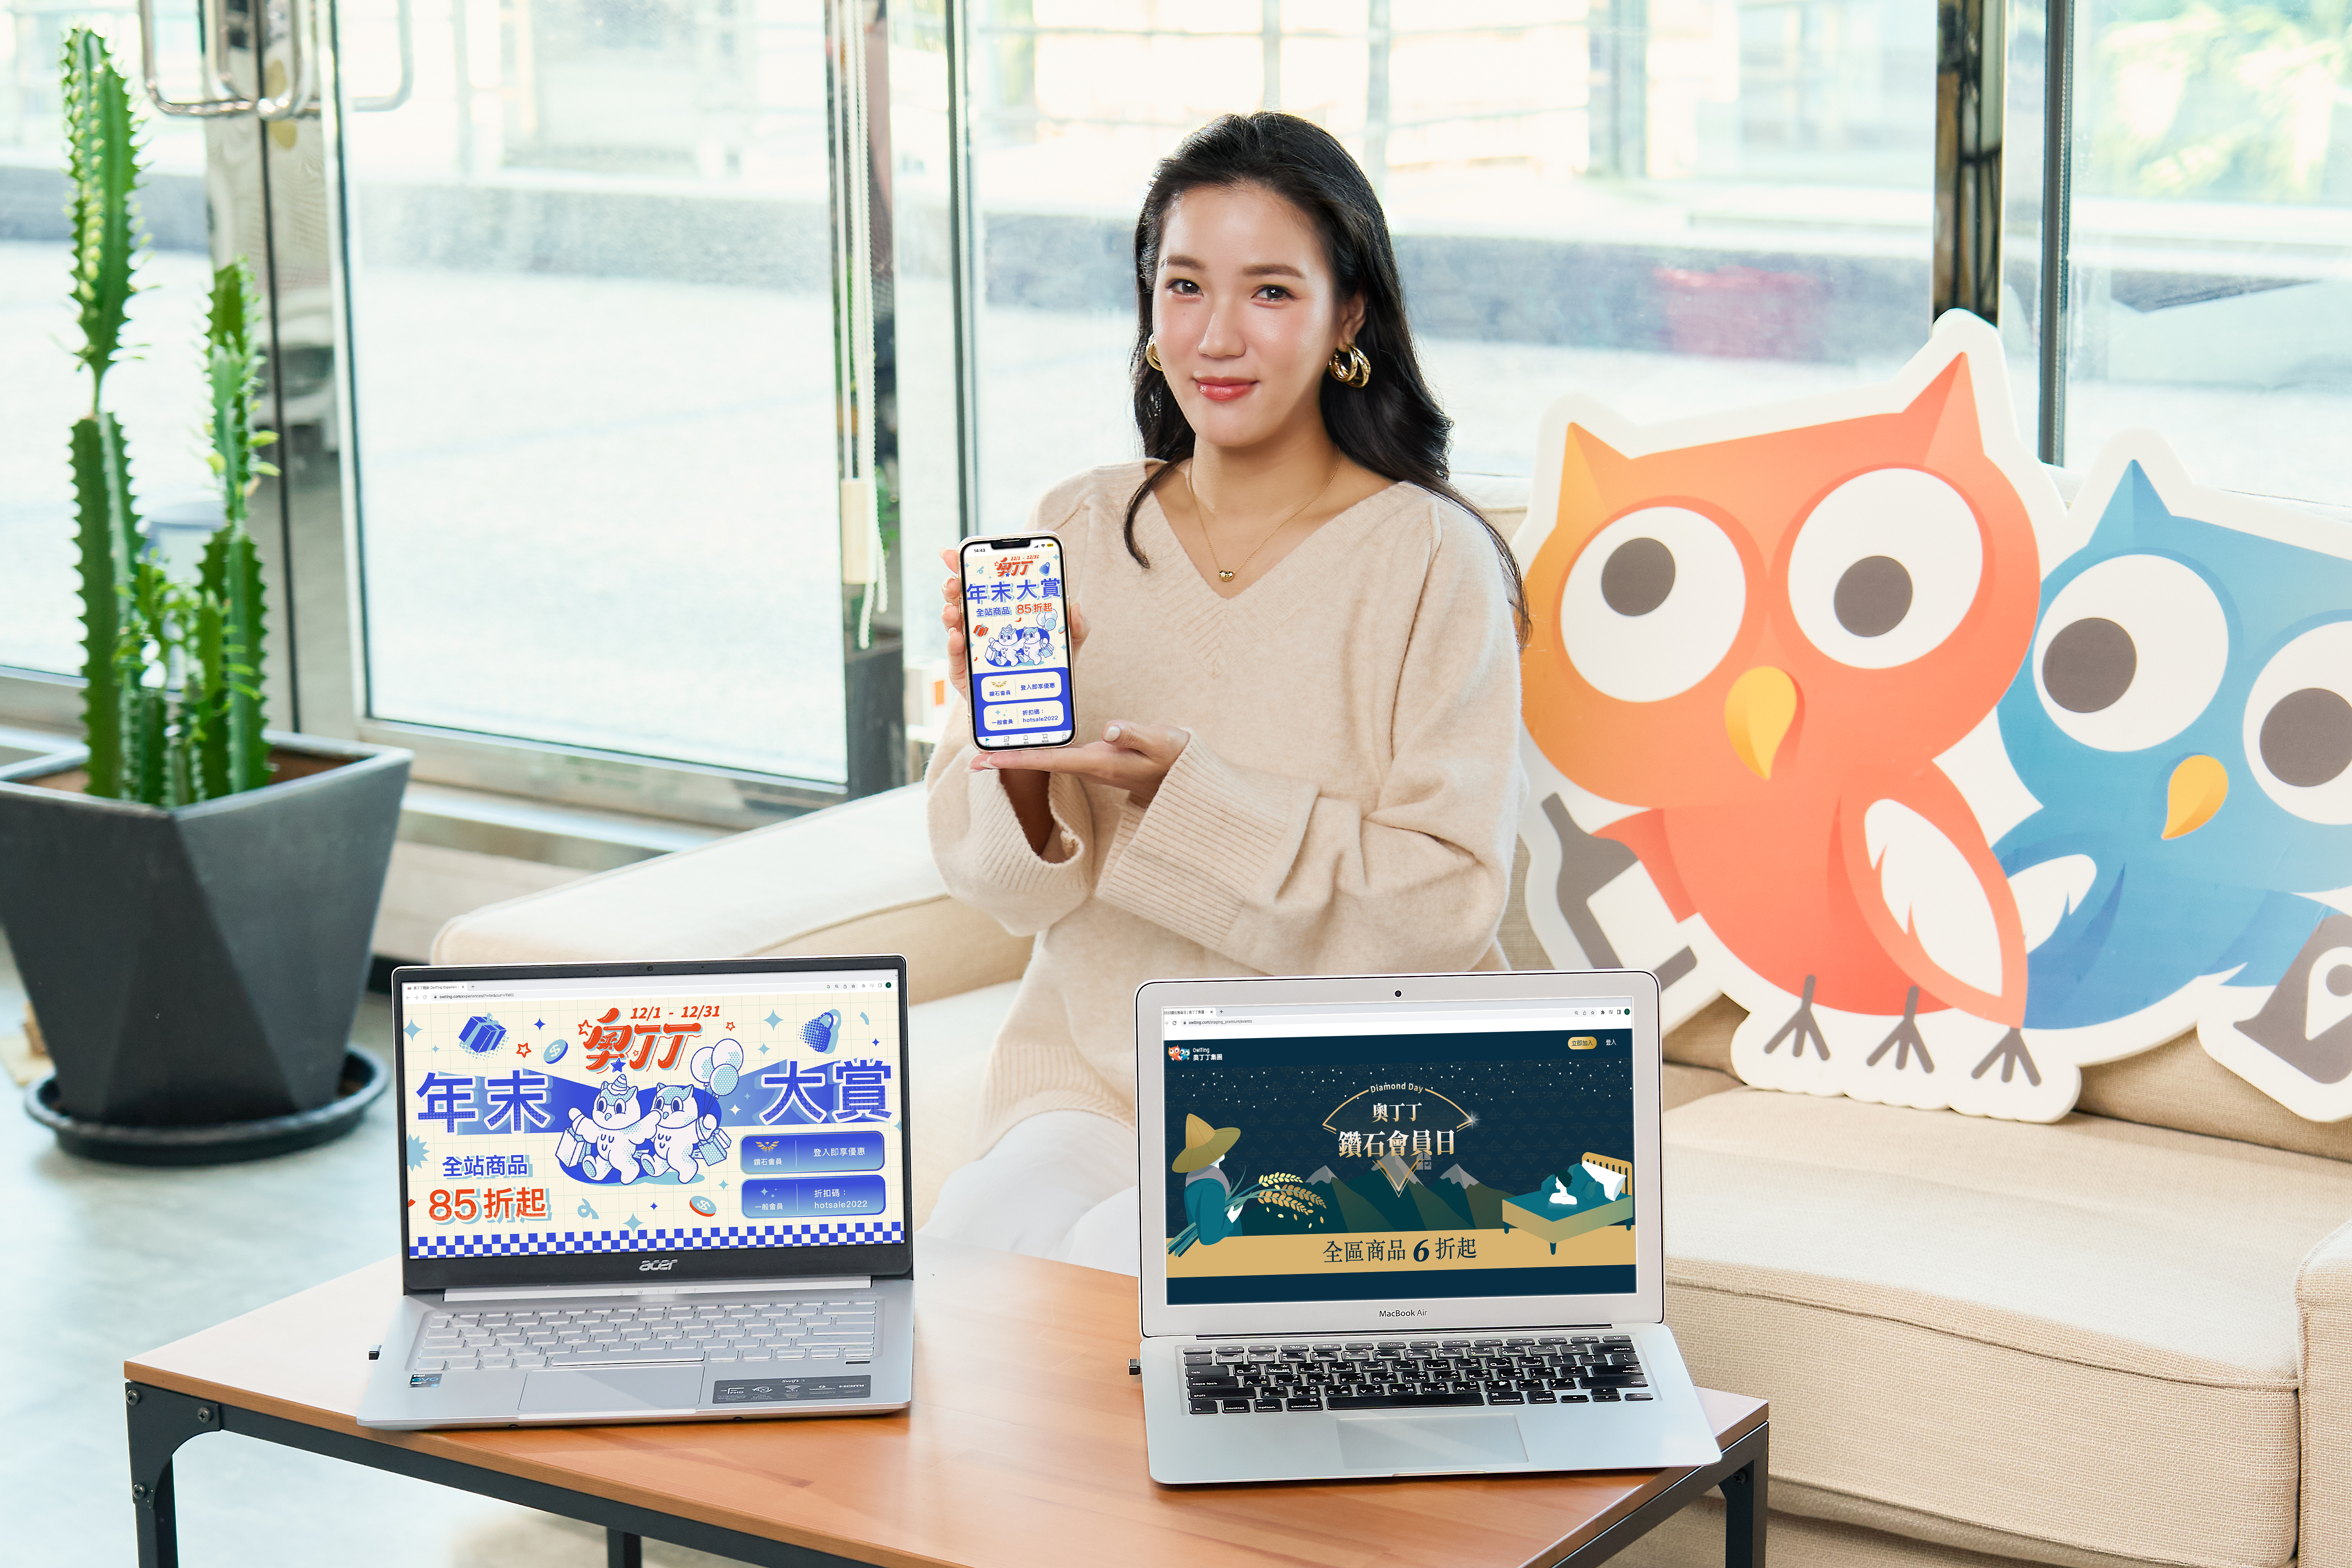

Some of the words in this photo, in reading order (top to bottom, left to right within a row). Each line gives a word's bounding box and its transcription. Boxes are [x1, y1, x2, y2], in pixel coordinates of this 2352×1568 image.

[996, 557, 1034, 578] 奧丁丁
[967, 577, 1062, 605] 年末大賞
[976, 606, 1010, 617] 全站商品
[1017, 602, 1053, 614] 85折起
[1021, 682, 1055, 691] 登入即享優惠
[630, 1007, 660, 1021] 12/1
[681, 1005, 720, 1019] 12/31
[583, 1008, 703, 1071] 奧丁丁
[415, 1067, 551, 1135] 年末
[760, 1057, 894, 1124] 大賞
[1370, 1082, 1406, 1093] Diamond
[1409, 1083, 1423, 1094] Day
[1372, 1102, 1422, 1123] 奧丁丁
[813, 1147, 865, 1157] 登入即享優惠
[1338, 1129, 1455, 1158] 鑽石會員日
[442, 1154, 528, 1177] 全站商品
[429, 1187, 546, 1221] 85折起
[814, 1200, 868, 1209] hotsale2022
[1323, 1239, 1406, 1263] 全區商品
[1413, 1239, 1429, 1262] 6
[1435, 1237, 1477, 1260] 折起
[639, 1259, 678, 1271] acer
